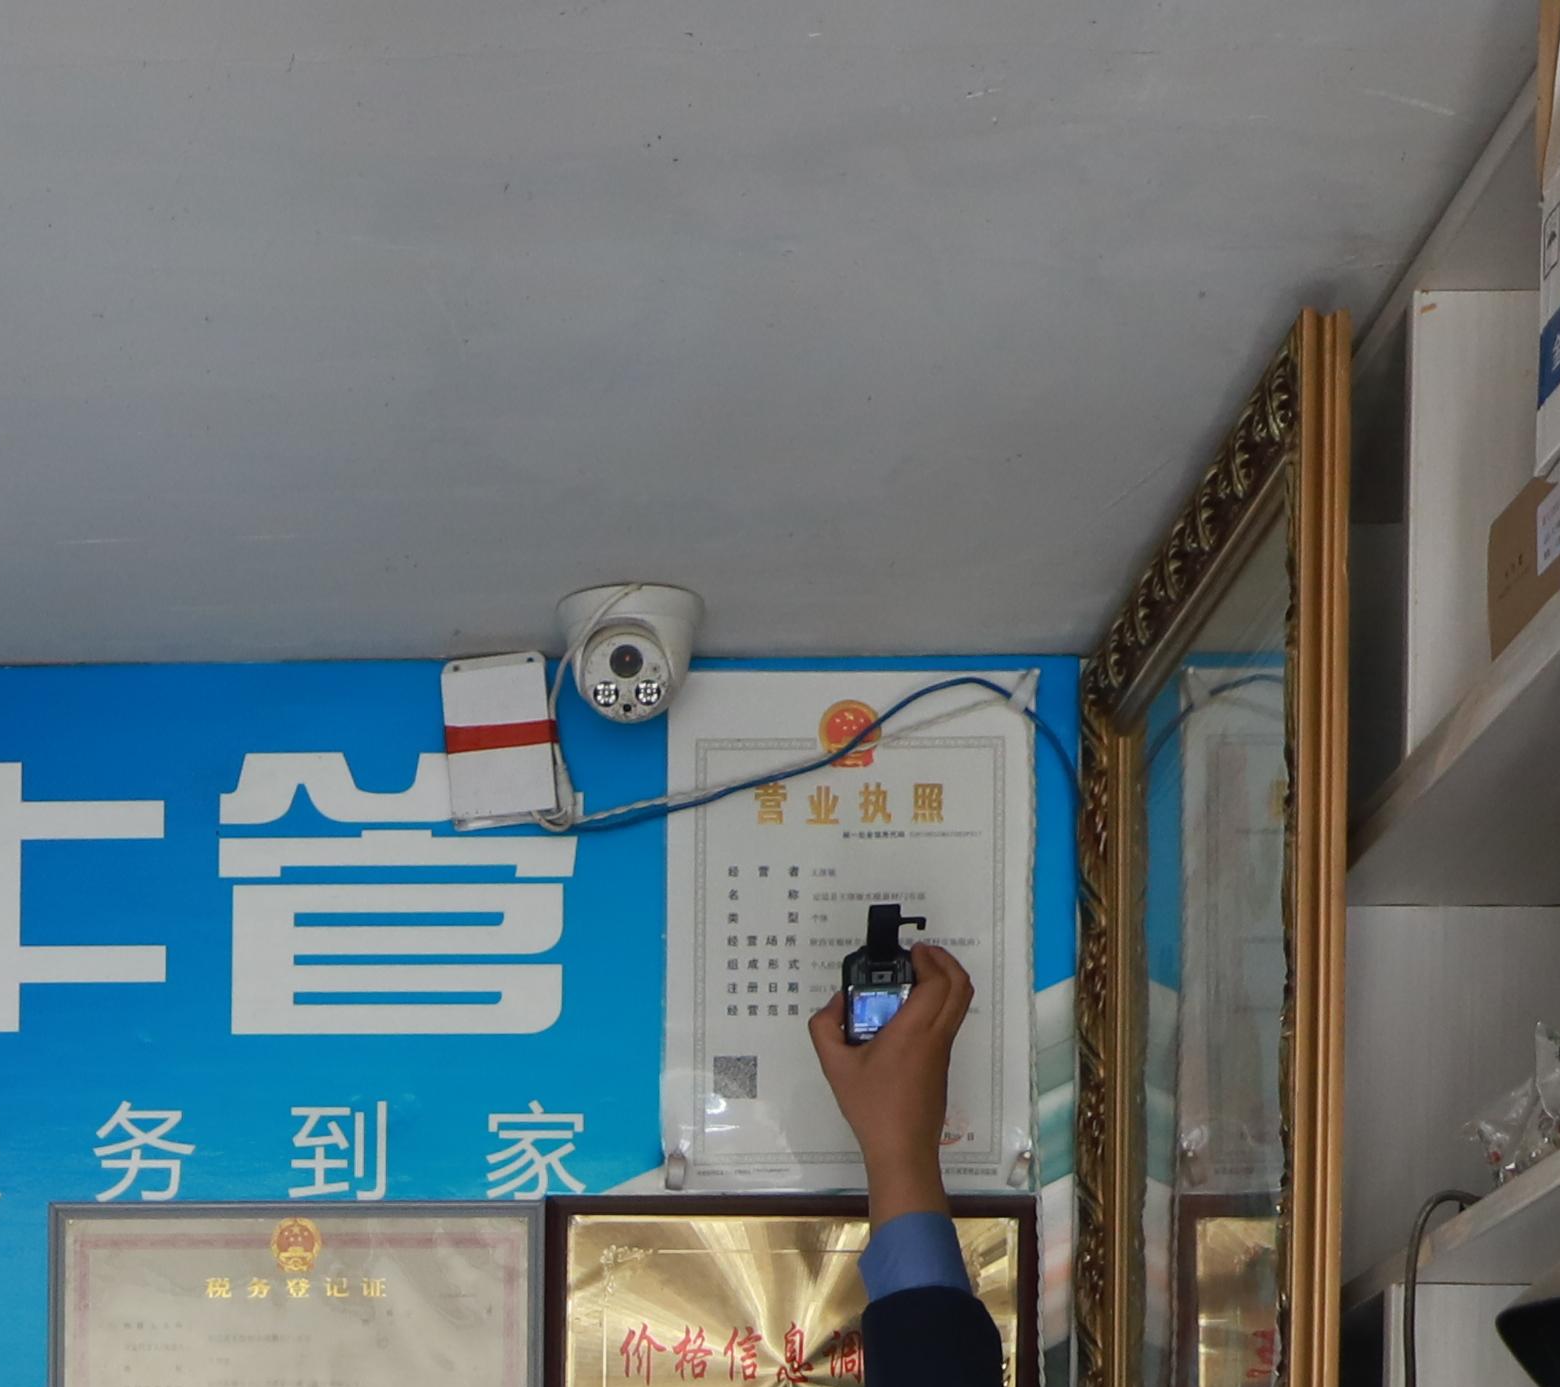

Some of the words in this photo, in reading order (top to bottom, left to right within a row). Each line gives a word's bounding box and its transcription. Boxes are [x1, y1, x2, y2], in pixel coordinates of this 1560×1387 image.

[754, 782, 944, 824] 营业执照
[728, 889, 799, 901] 名称
[728, 912, 799, 924] 类型
[727, 935, 797, 947] 经营场所
[727, 958, 799, 970] 组成形式
[727, 982, 799, 994] 注册日期
[205, 1277, 387, 1298] 税务登记证
[619, 1320, 864, 1386] 价格信息调
